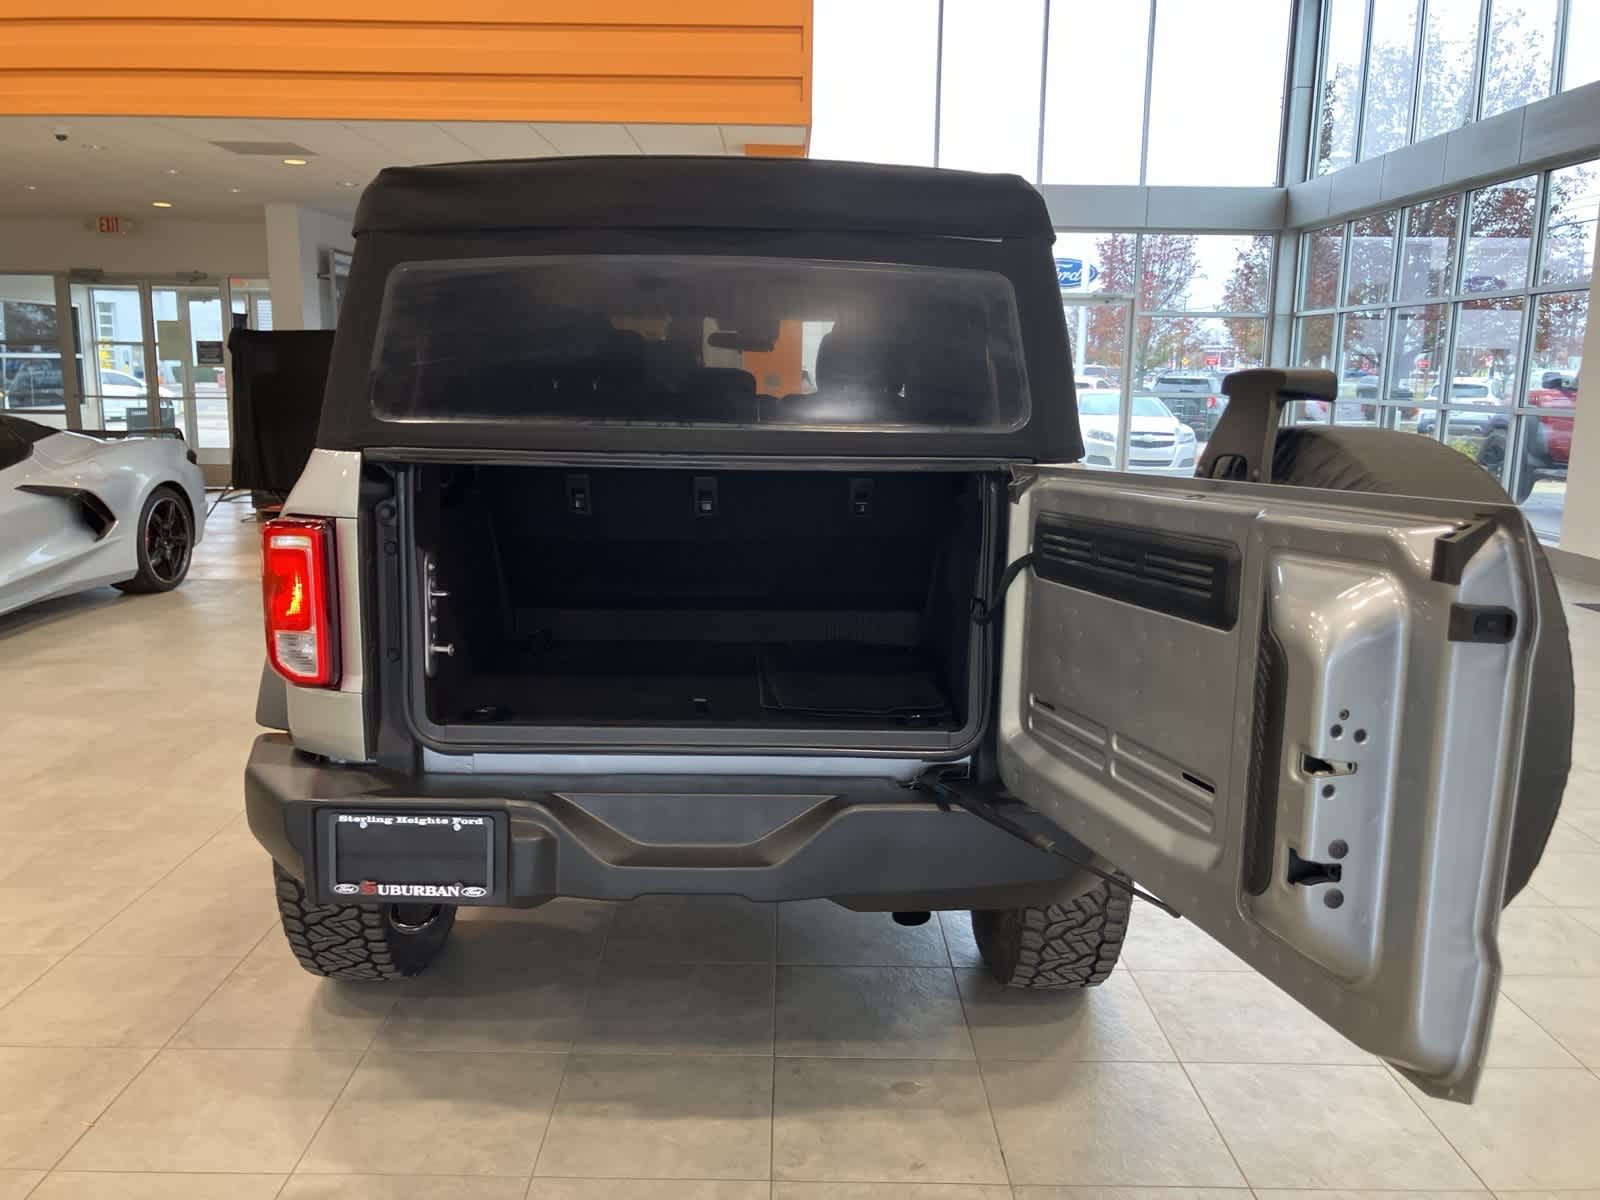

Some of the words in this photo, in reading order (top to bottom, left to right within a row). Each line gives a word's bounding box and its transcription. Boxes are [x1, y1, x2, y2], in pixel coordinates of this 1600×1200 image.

[99, 215, 121, 233] EXIT
[339, 815, 394, 824] Sterling
[396, 816, 449, 825] Heights
[452, 817, 484, 825] Ford
[361, 880, 460, 896] SUBURBAN
